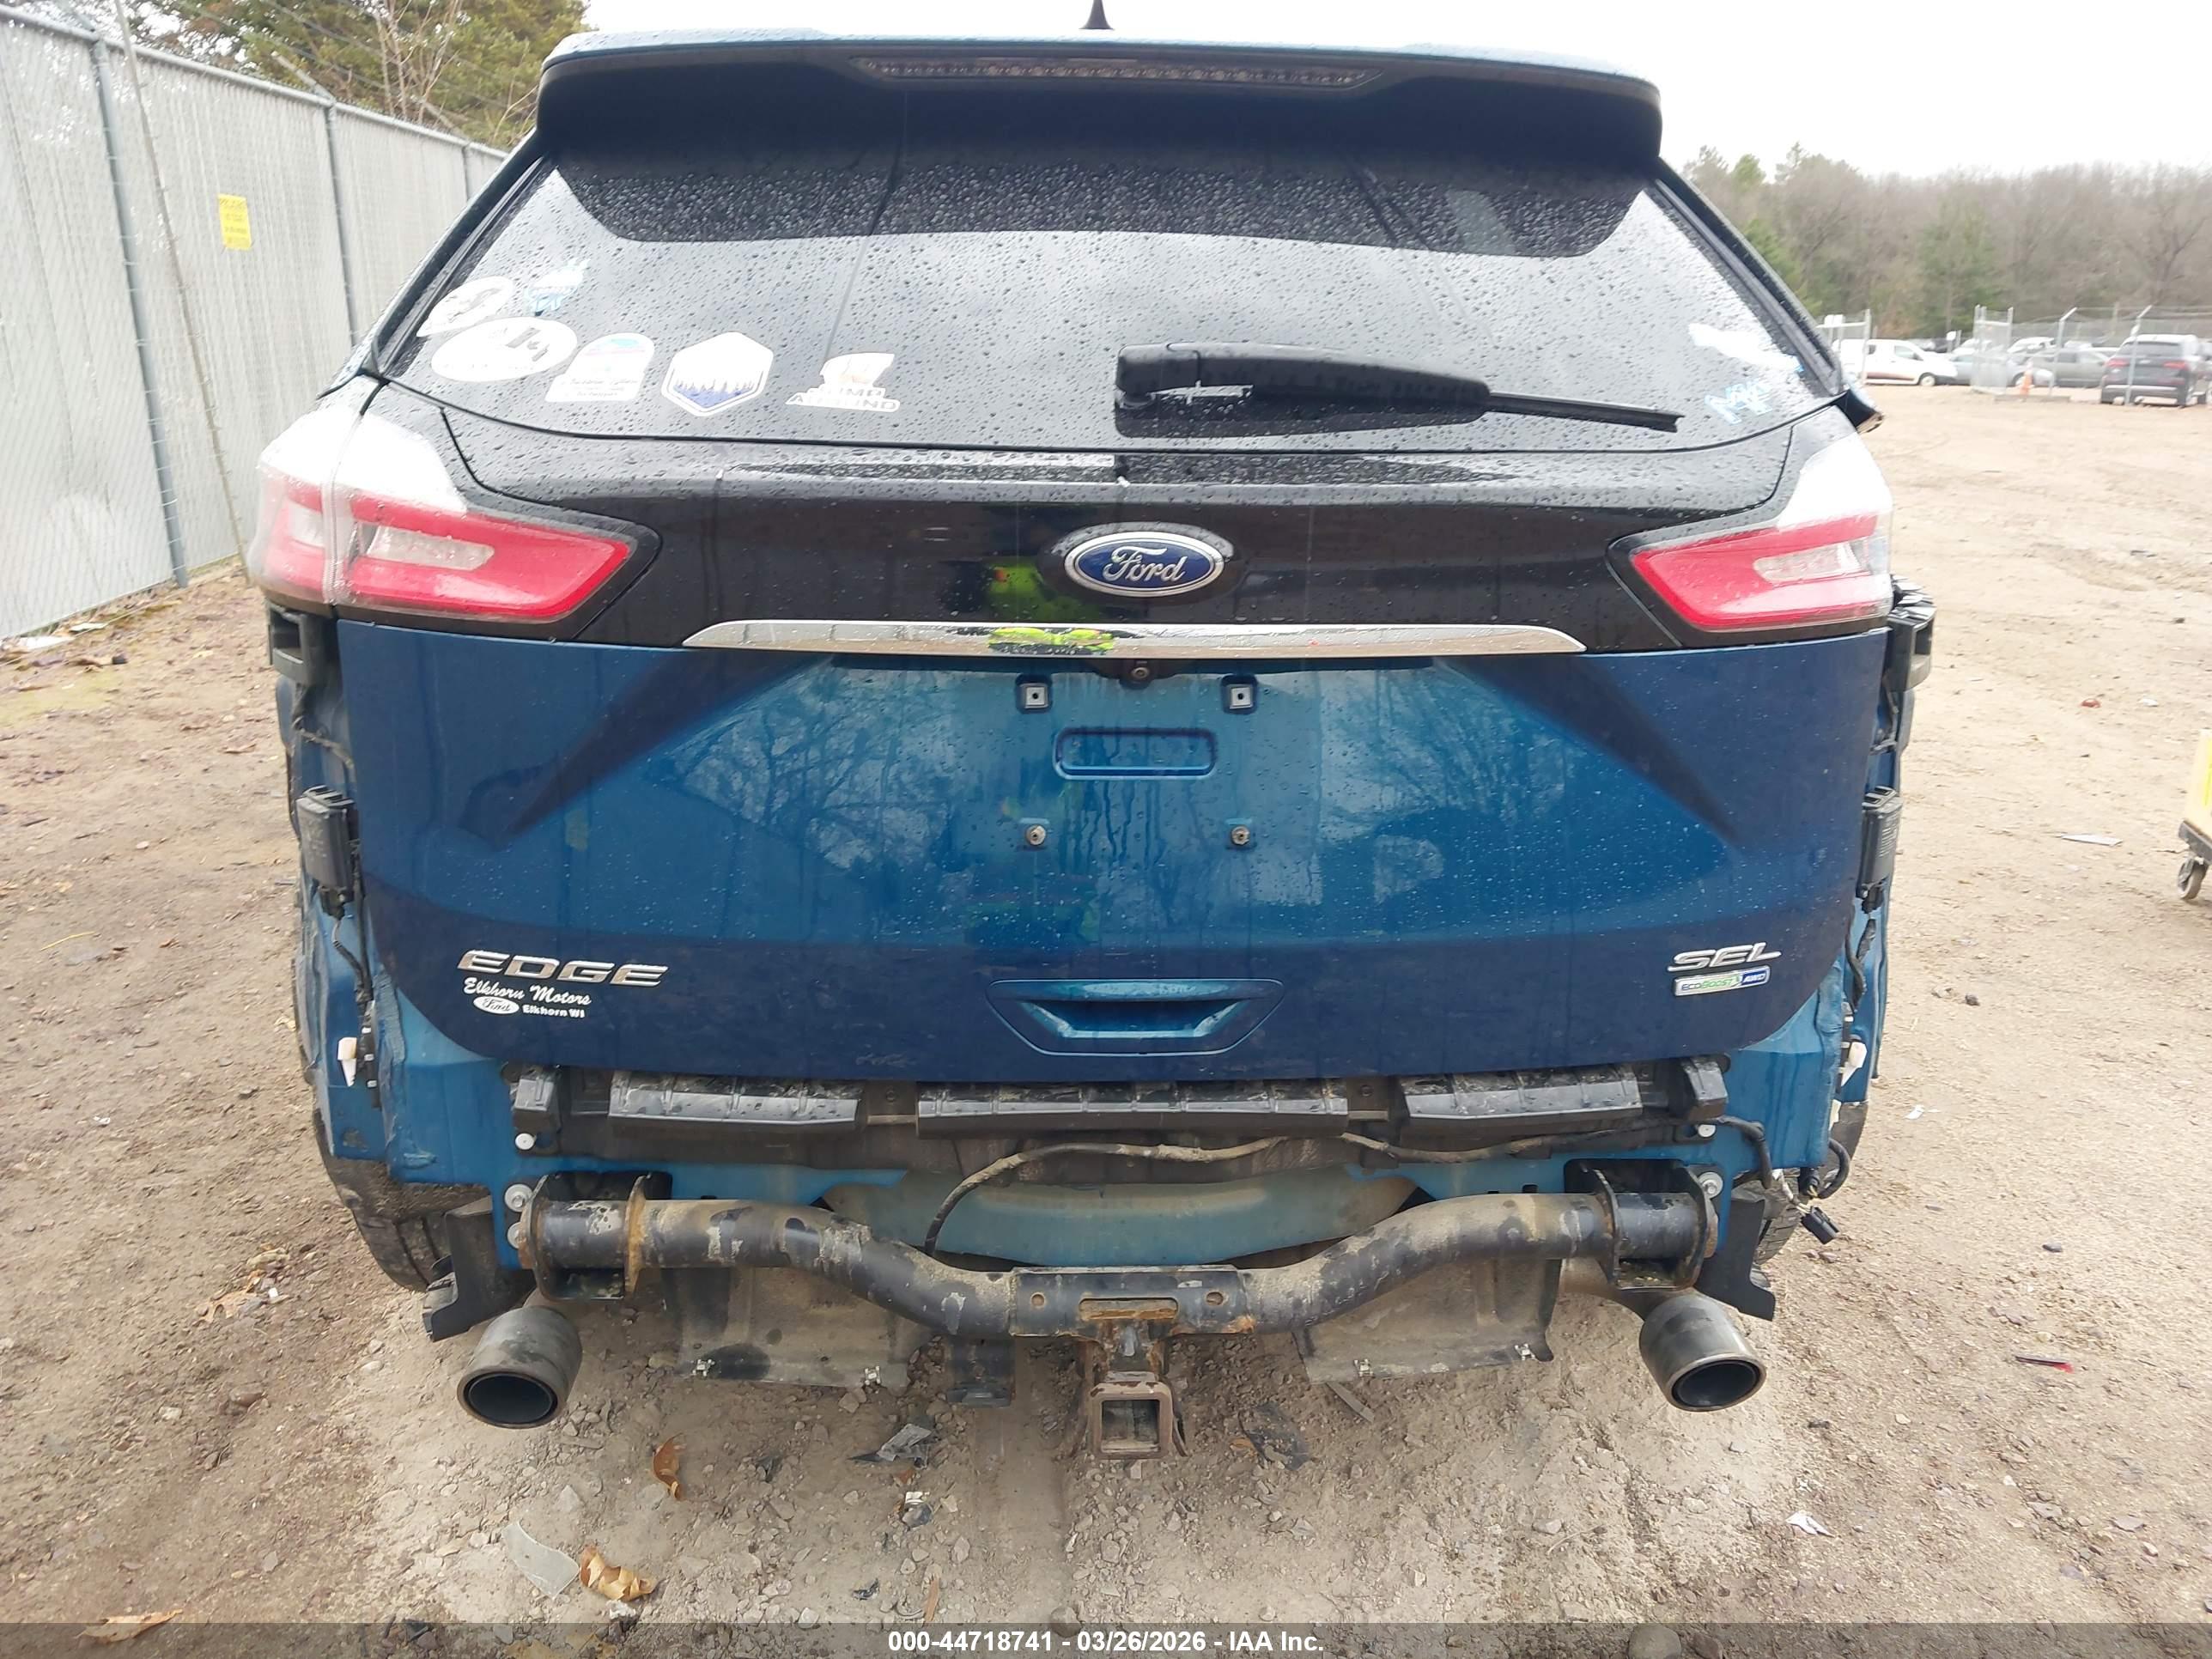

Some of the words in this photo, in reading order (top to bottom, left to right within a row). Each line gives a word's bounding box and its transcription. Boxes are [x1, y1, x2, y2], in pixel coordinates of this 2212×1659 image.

[1103, 545, 1188, 583] Ford
[457, 949, 668, 987] EDGE
[1668, 942, 1782, 972] SEL
[463, 977, 526, 1000] Elkhorn
[530, 985, 592, 1006] Motors
[522, 1004, 568, 1017] Elkhorn
